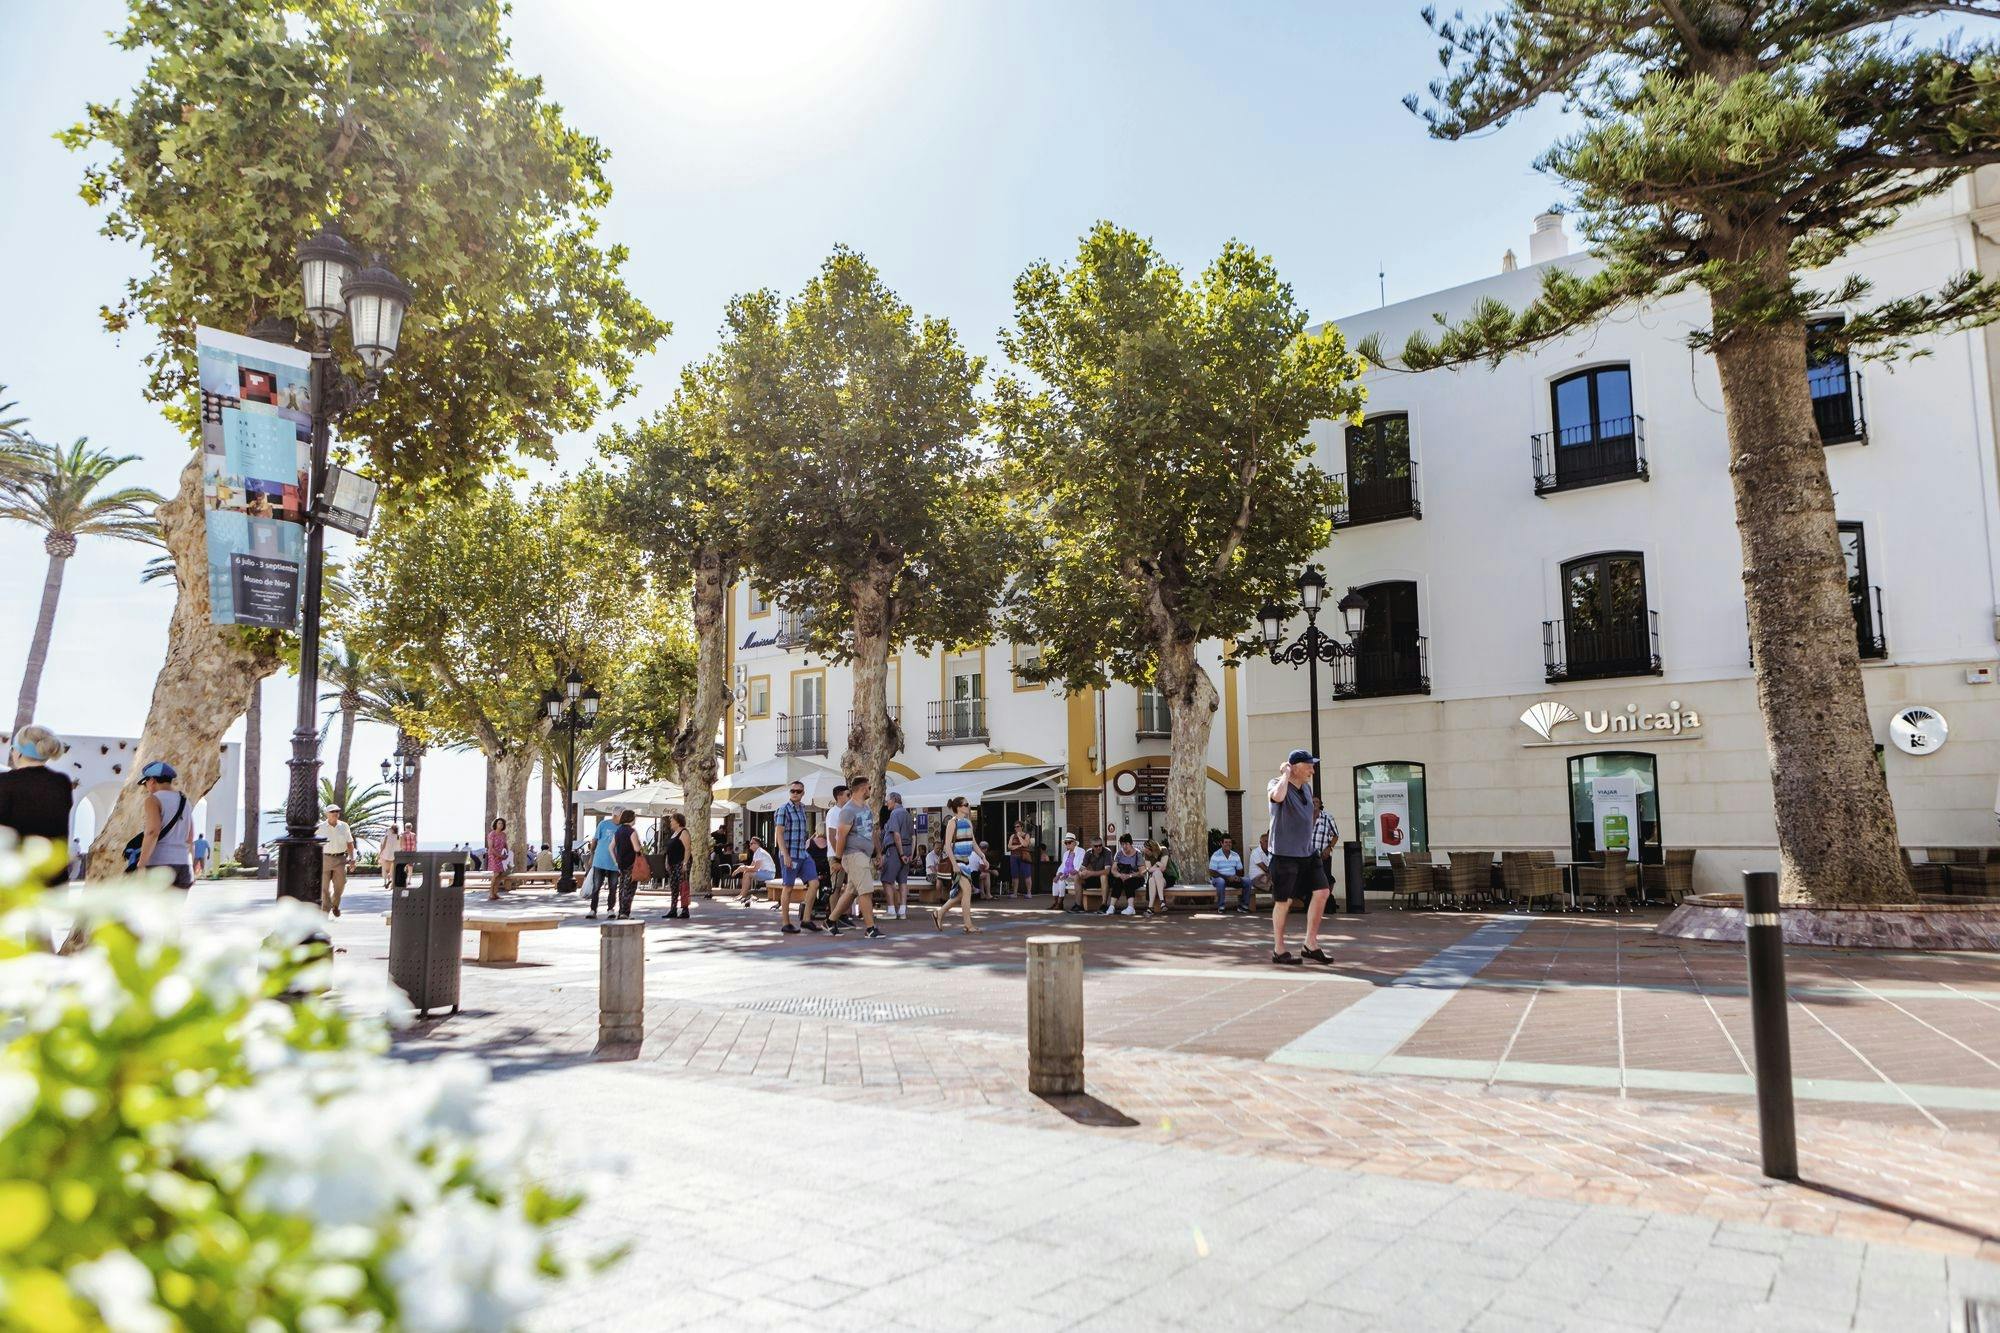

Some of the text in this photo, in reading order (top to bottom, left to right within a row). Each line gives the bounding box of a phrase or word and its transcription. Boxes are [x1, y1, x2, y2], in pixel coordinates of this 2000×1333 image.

[241, 557, 255, 566] julio
[243, 574, 291, 589] Museo de Nerja
[1584, 700, 1700, 735] Unicaja
